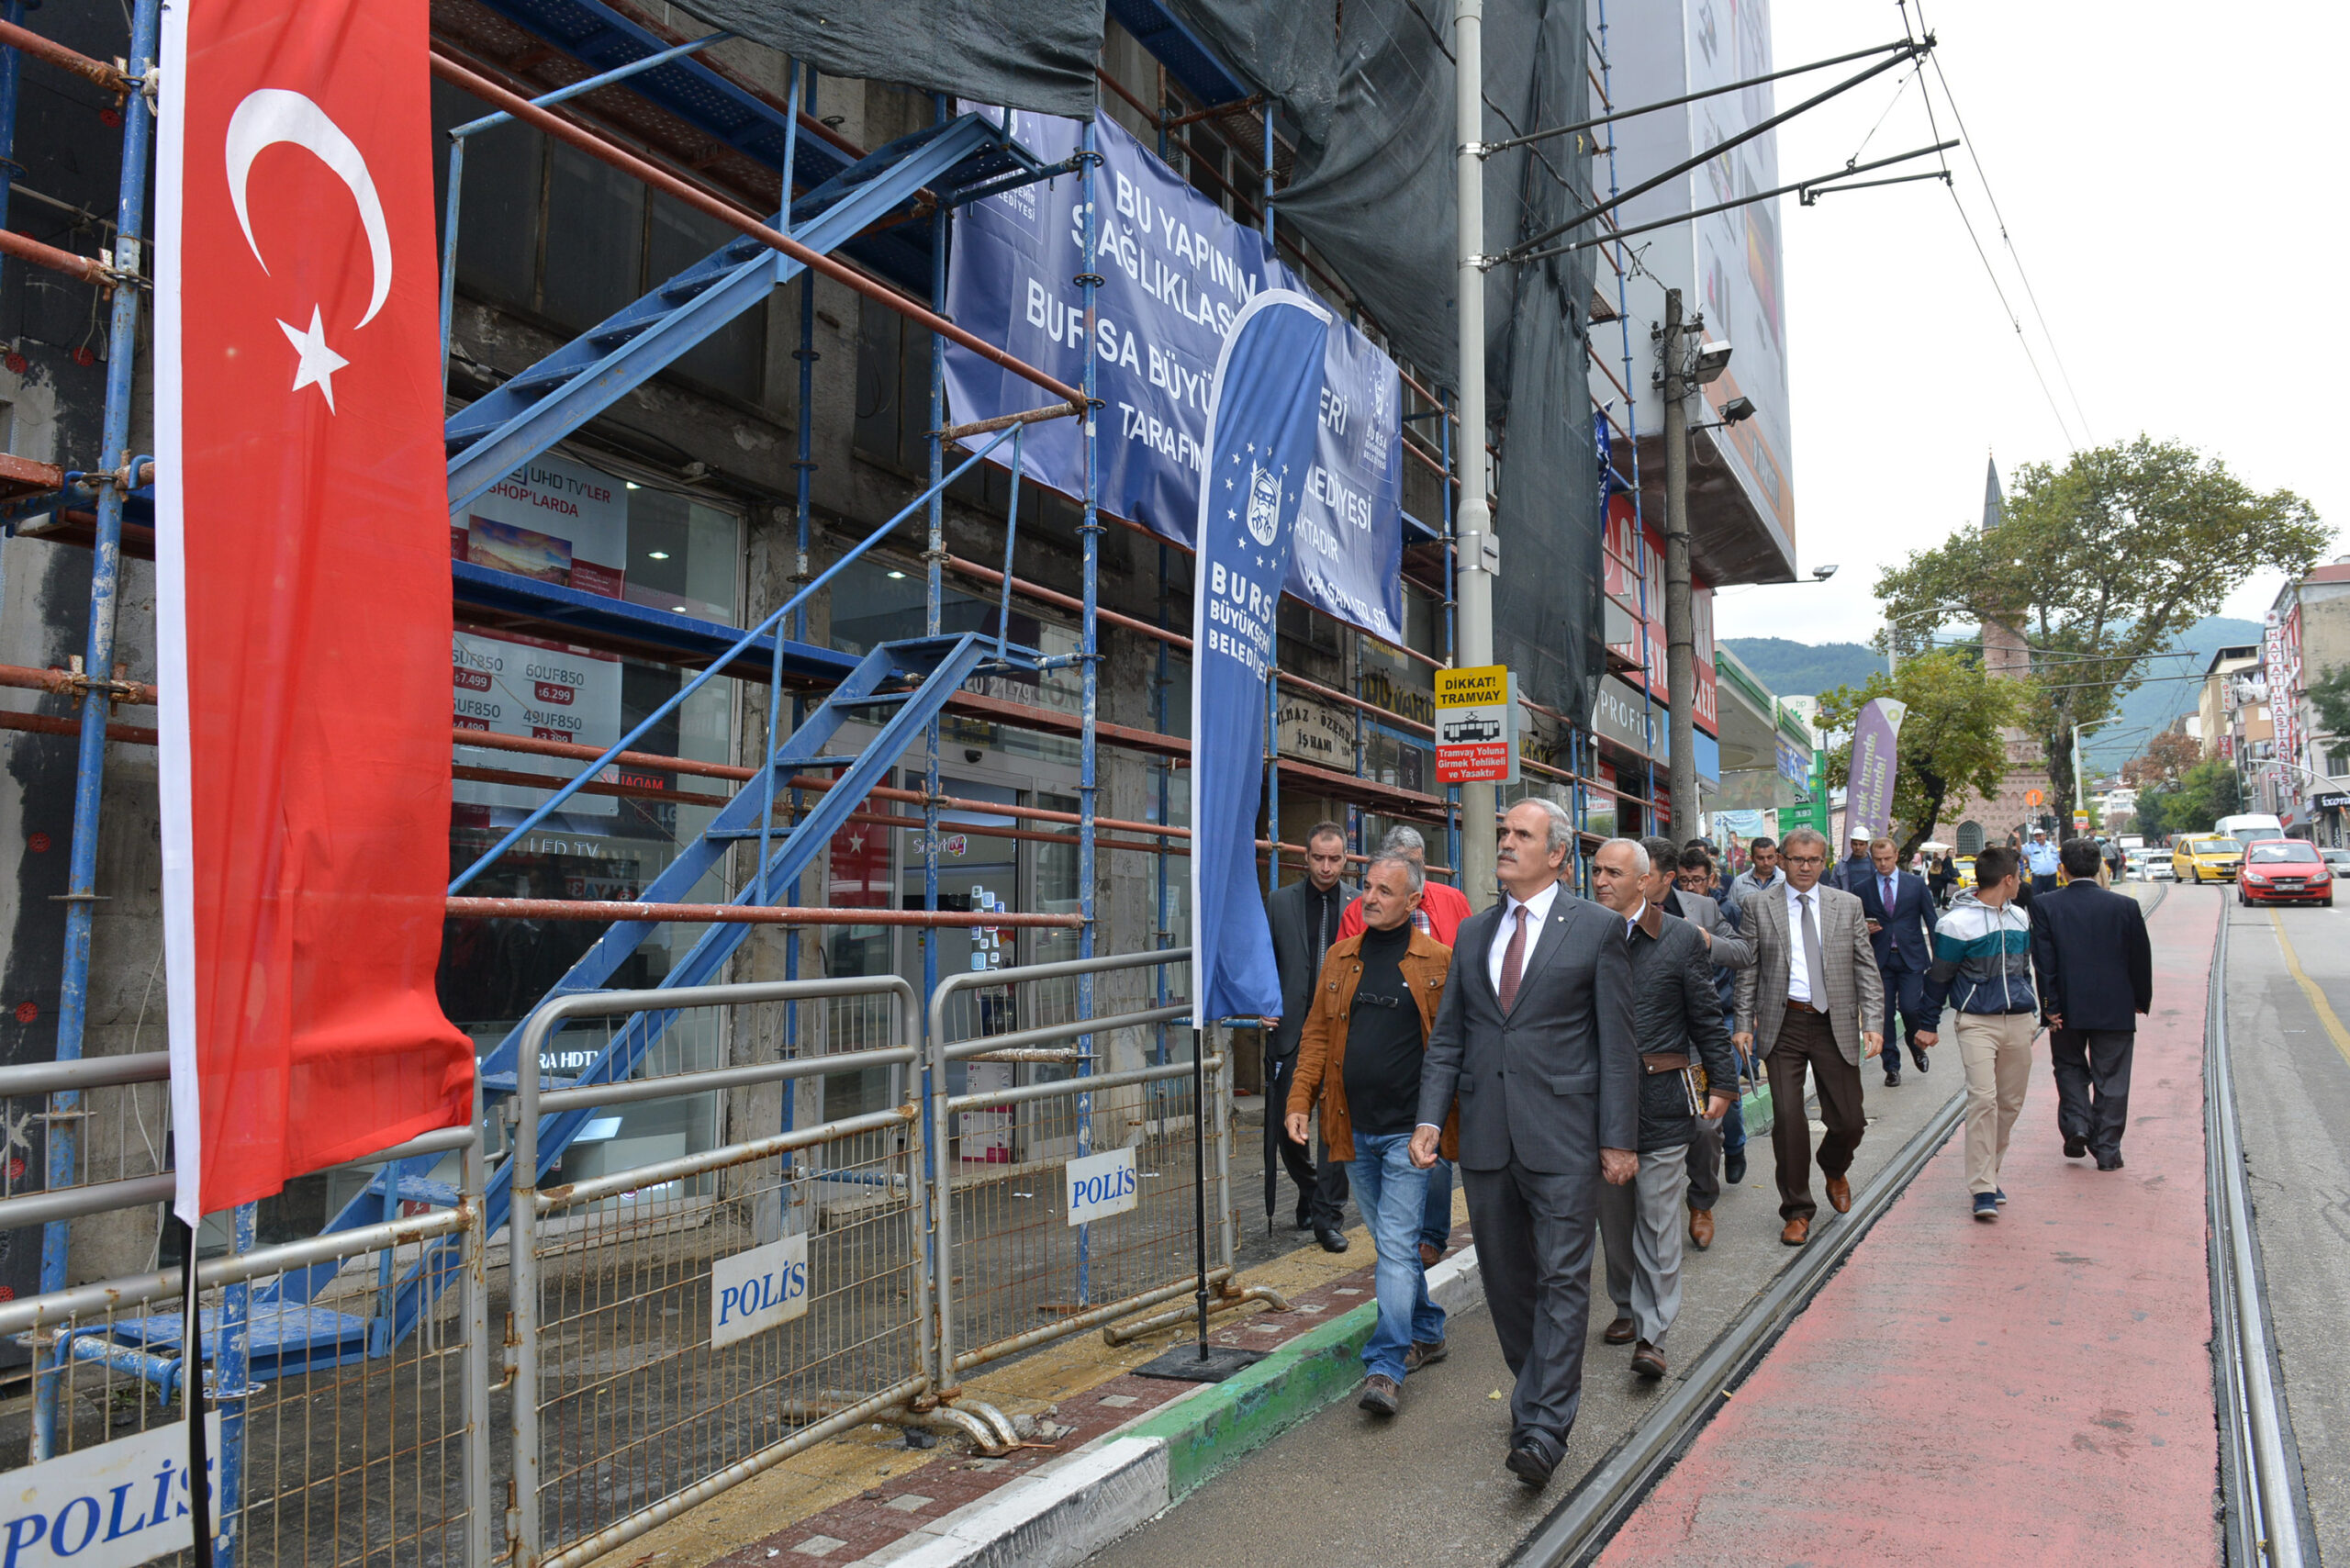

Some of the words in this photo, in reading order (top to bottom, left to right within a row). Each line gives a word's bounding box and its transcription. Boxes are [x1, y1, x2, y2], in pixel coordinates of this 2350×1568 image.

[1116, 170, 1152, 233] BU
[1158, 207, 1256, 305] YAPININ
[1027, 277, 1140, 376] BURSA
[1148, 343, 1214, 416] BÜYÜ
[1318, 386, 1348, 436] ERİ
[1118, 401, 1203, 472] TARAFIN
[531, 466, 563, 490] UHD
[1305, 465, 1372, 532] LEDİYESİ
[1294, 510, 1339, 564] AKTADIR
[1211, 561, 1272, 624] BURS
[453, 649, 504, 672] 5UF850
[525, 664, 585, 686] 60UF850
[2269, 631, 2280, 686] HAYAT
[1440, 690, 1501, 704] TRAMVAY
[1445, 677, 1496, 690] DİKKAT!
[2222, 684, 2231, 711] OTEL
[522, 709, 582, 730] 49UF850
[1277, 706, 1309, 727] ILMAZ
[1438, 748, 1474, 758] Tramvay
[1476, 746, 1505, 756] Yoluna
[1438, 758, 1469, 768] Girmek
[1471, 756, 1506, 767] Tehlikeli
[1460, 767, 1495, 778] Yasaktır
[560, 1051, 599, 1068] HDT
[1072, 1164, 1136, 1209] POLİS
[718, 1260, 806, 1327] POLİS
[4, 1457, 214, 1568] POLİS
